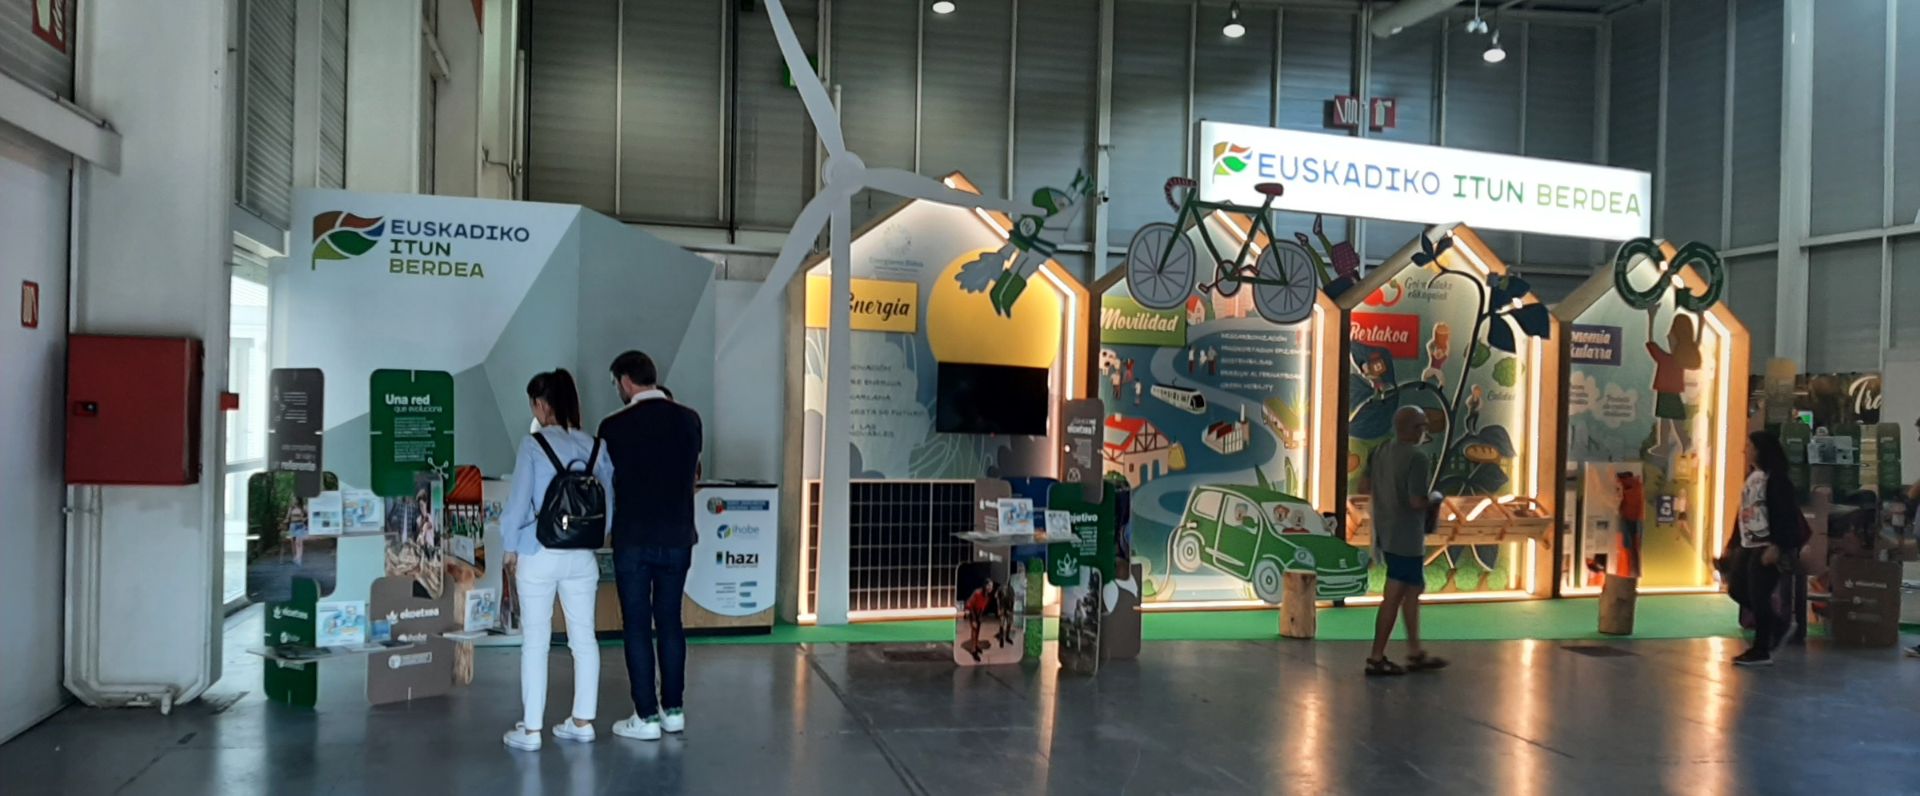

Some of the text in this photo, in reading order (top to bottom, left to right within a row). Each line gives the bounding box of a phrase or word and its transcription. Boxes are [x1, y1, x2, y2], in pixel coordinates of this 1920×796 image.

[1258, 152, 1642, 218] EUSKADIKO ITUN BERDEA
[390, 219, 530, 243] EUSKADIKO
[389, 239, 451, 257] ITUN
[388, 258, 485, 278] BERDEA
[1101, 306, 1180, 332] Movilidad
[385, 393, 431, 406] Una red
[1070, 511, 1099, 524] jetivo
